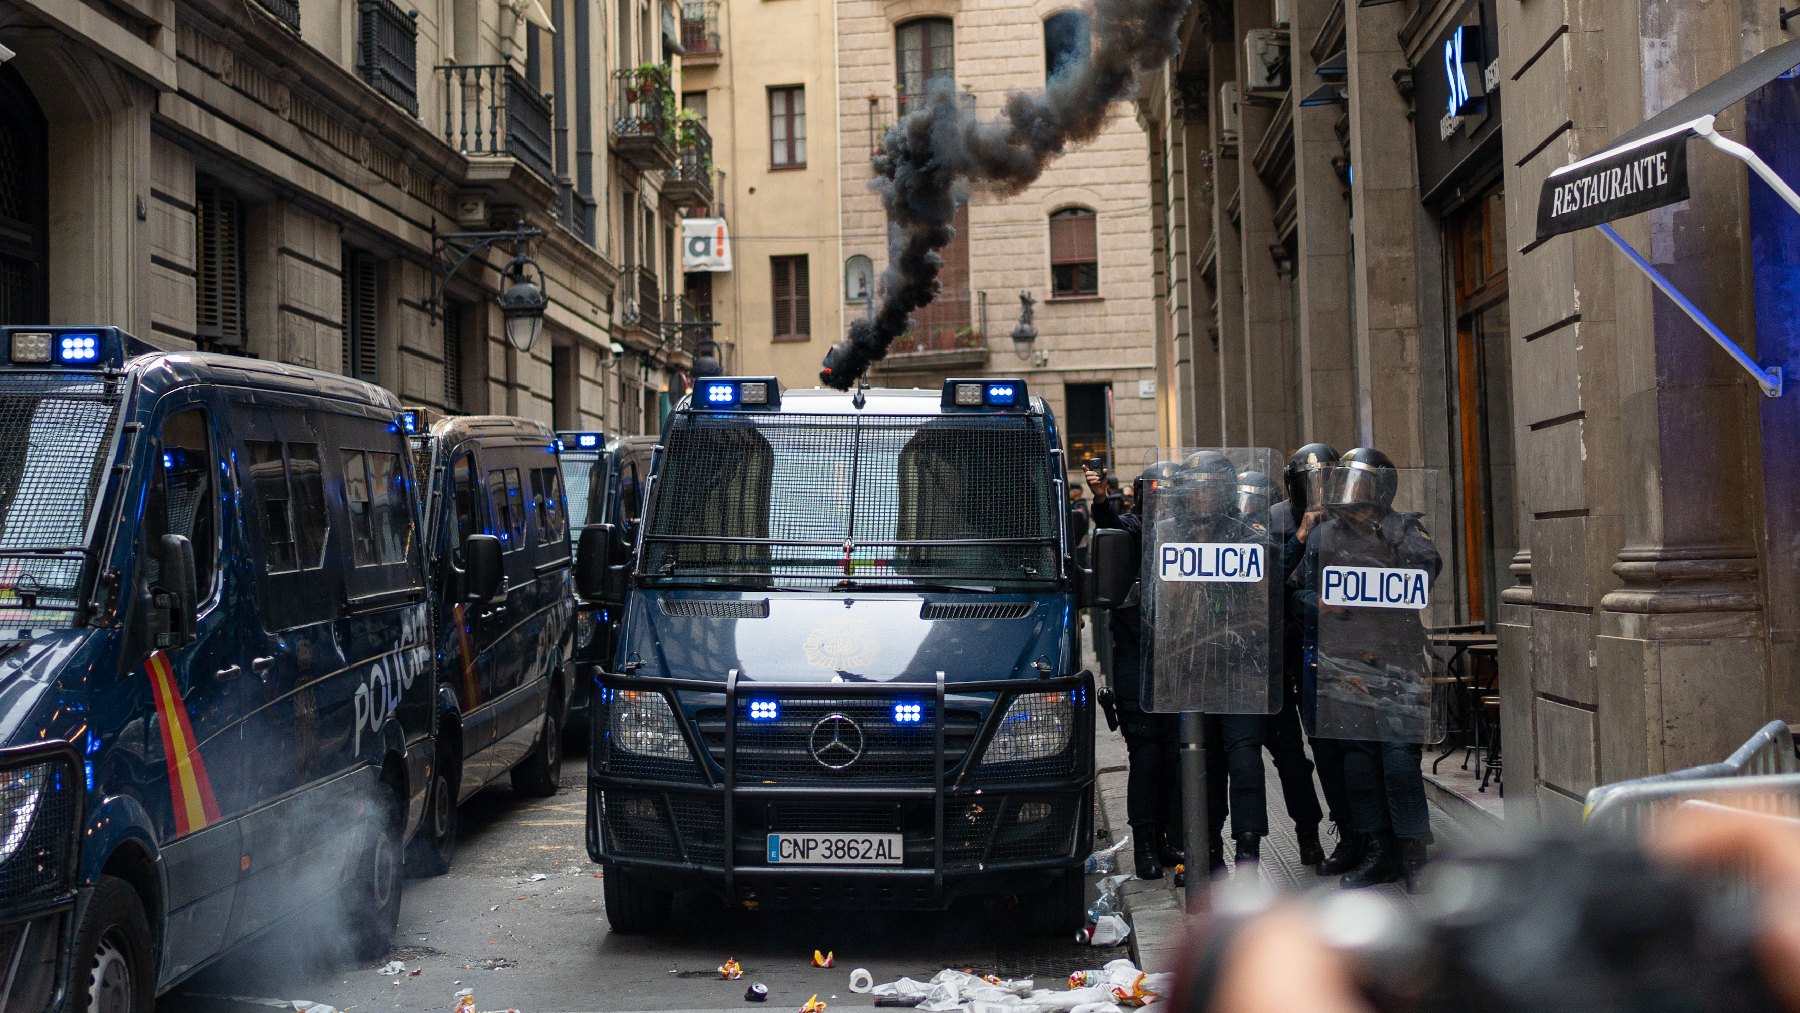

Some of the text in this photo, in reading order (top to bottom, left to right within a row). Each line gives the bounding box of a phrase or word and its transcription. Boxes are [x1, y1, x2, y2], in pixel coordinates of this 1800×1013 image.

[1445, 25, 1468, 117] SK
[1551, 151, 1668, 218] RESTAURANTE
[1162, 547, 1262, 578] POLICIA
[1325, 570, 1426, 605] POLICIA
